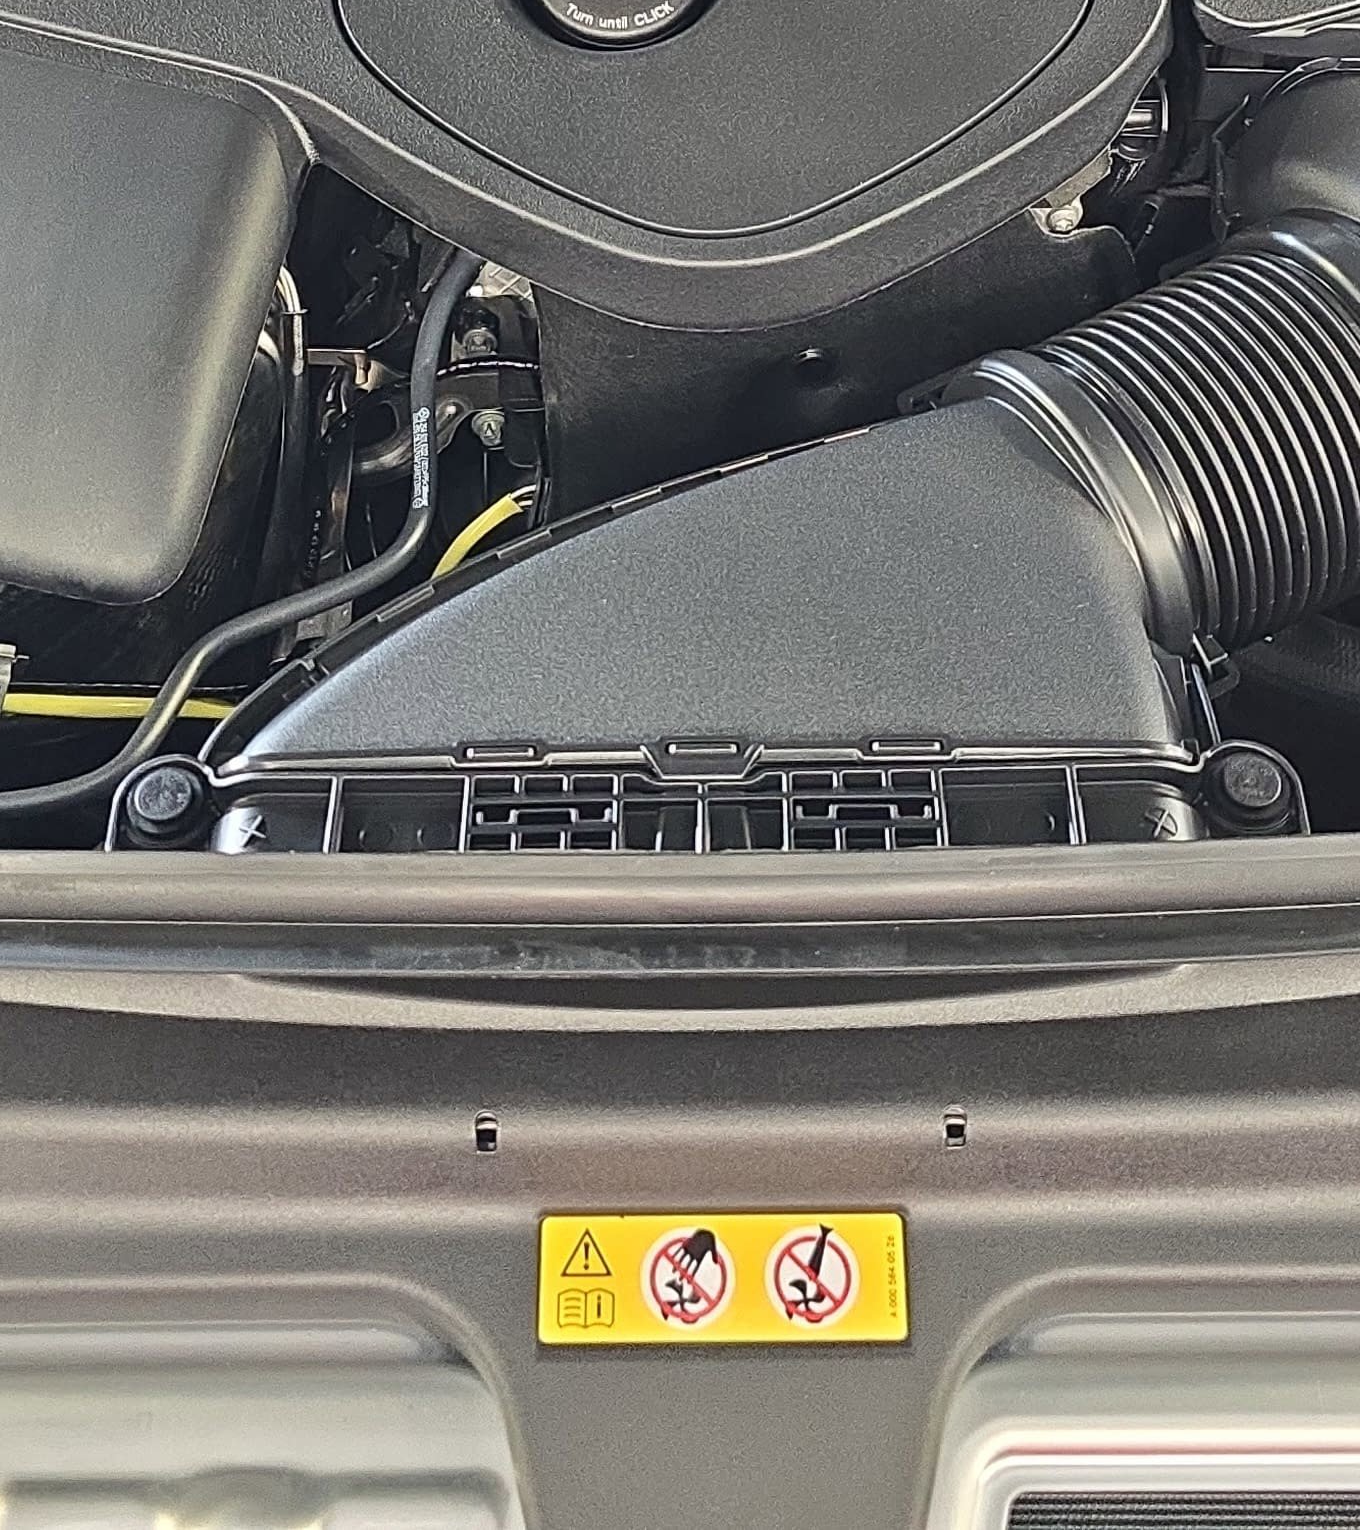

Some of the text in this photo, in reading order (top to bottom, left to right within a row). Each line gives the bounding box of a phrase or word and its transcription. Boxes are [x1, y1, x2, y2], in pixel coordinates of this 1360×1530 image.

[566, 0, 675, 29] Turn until CLICK
